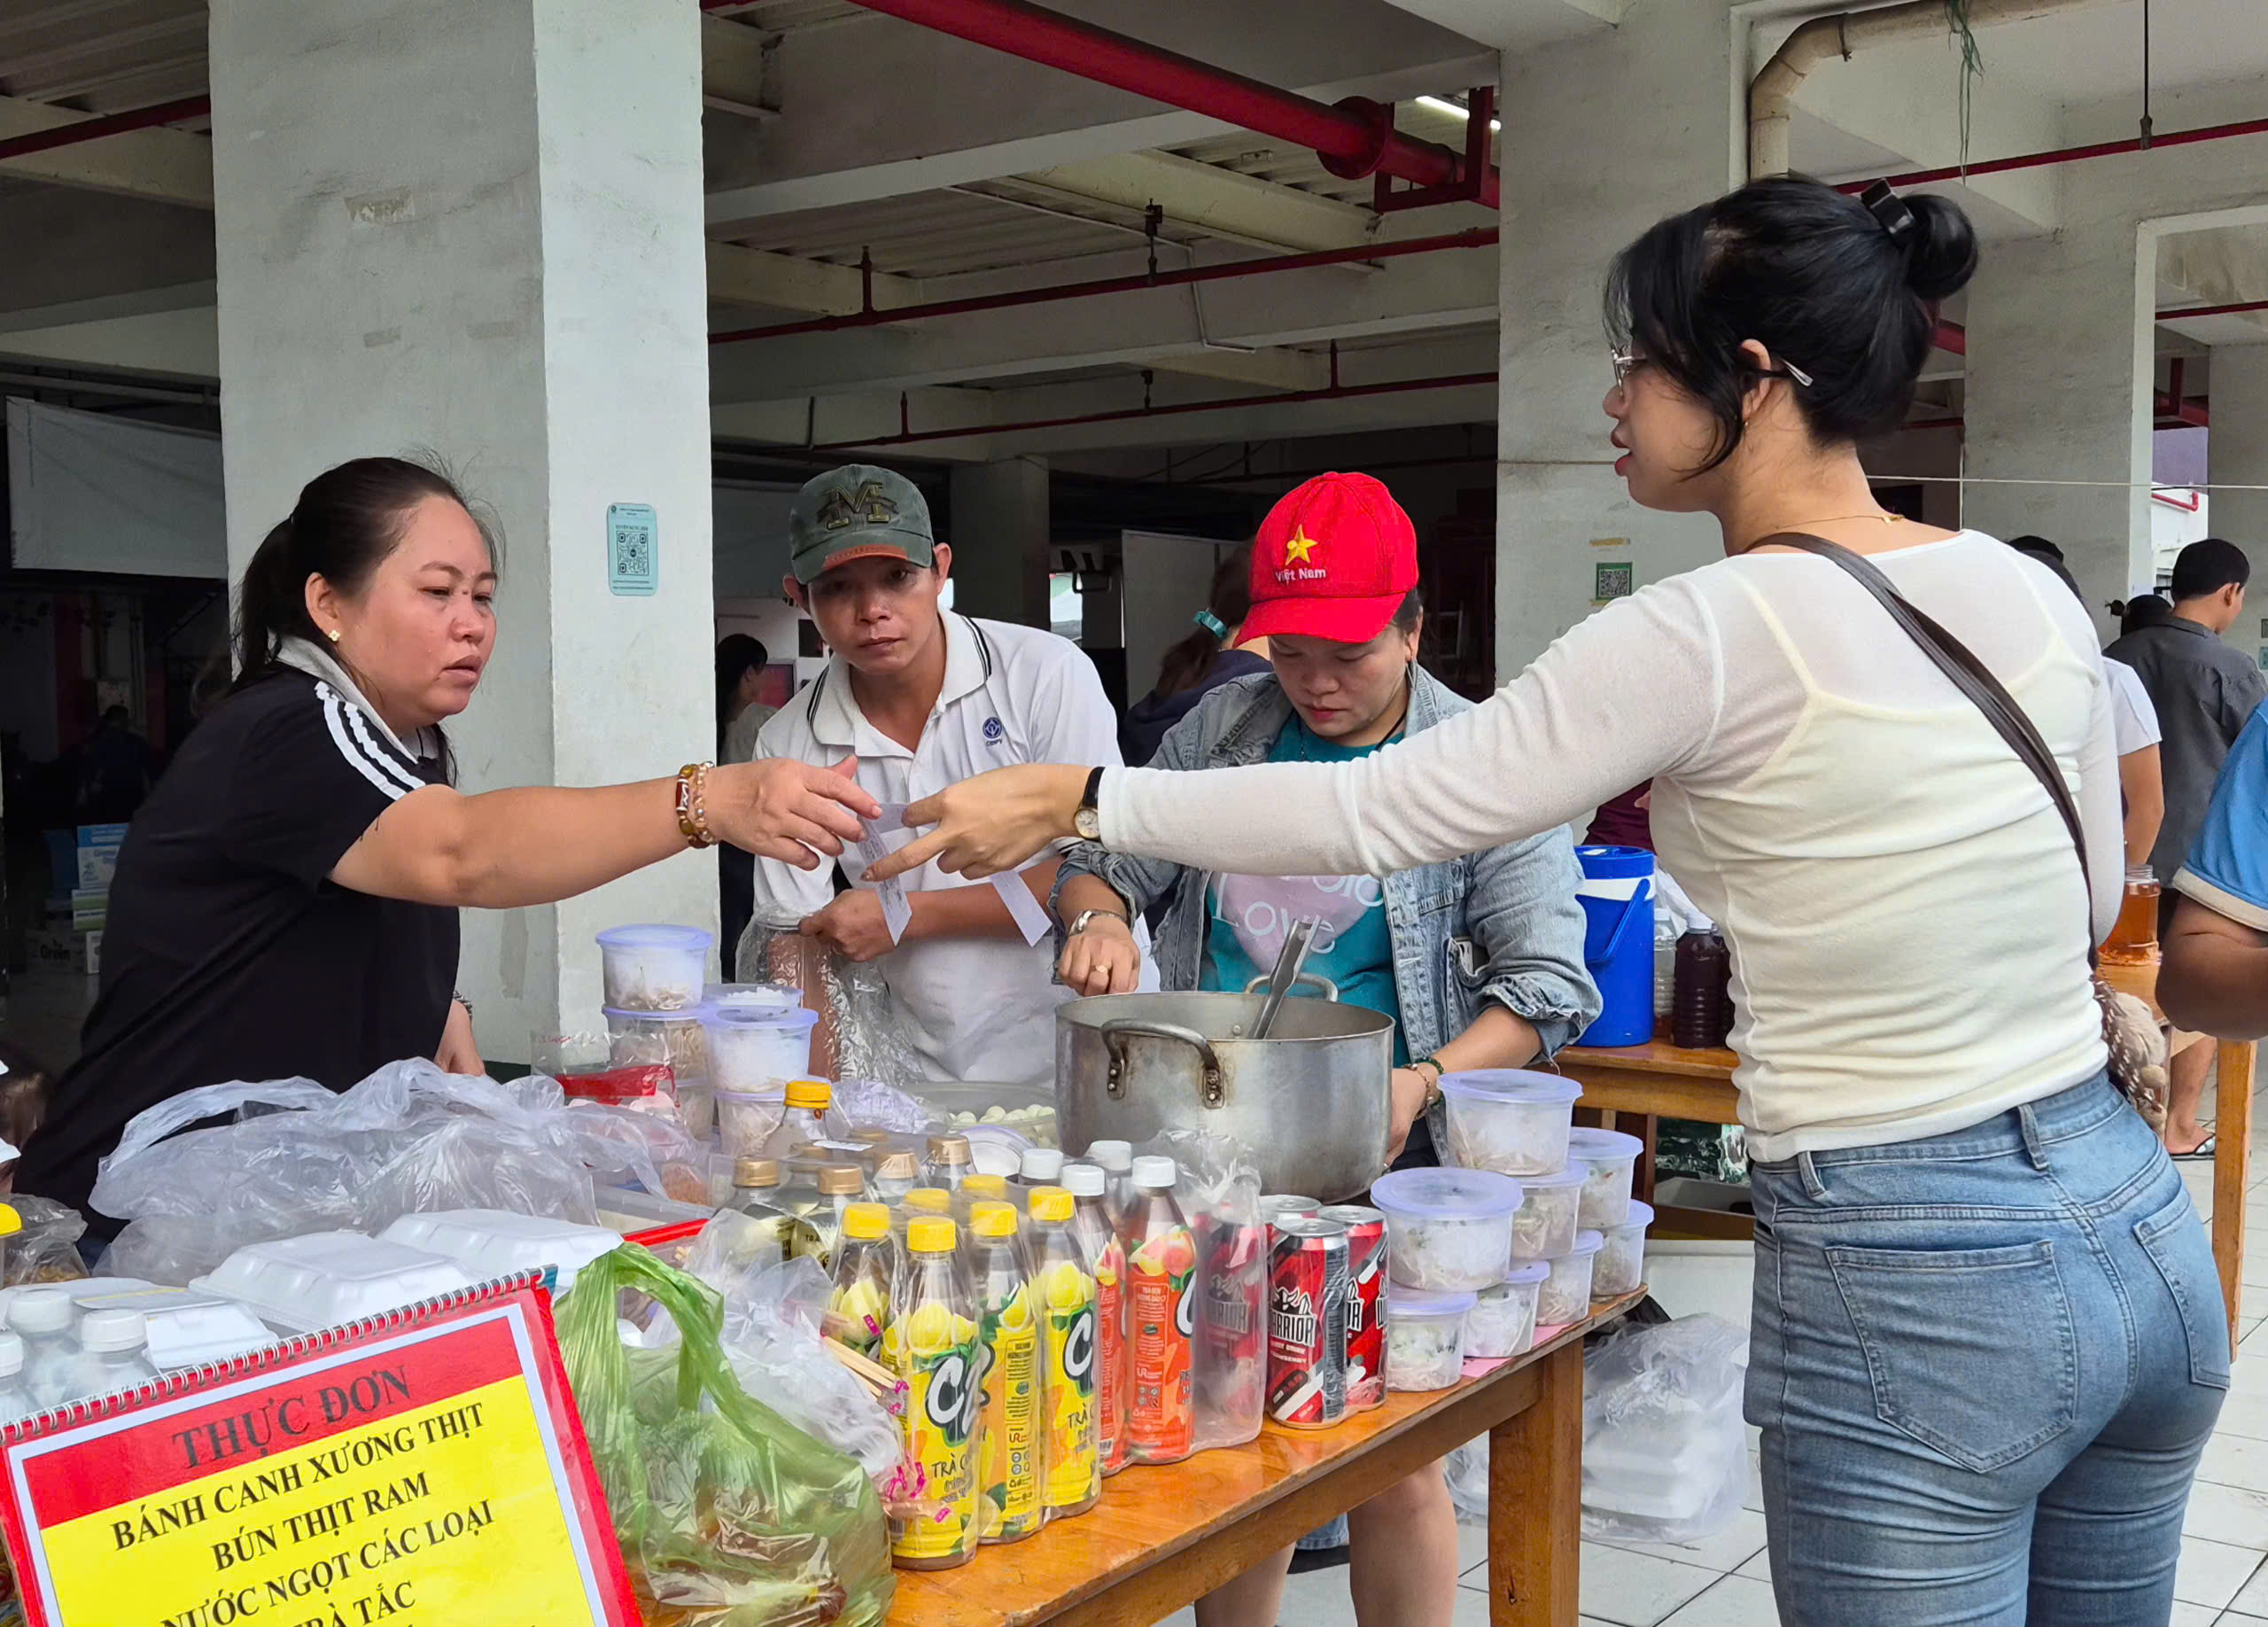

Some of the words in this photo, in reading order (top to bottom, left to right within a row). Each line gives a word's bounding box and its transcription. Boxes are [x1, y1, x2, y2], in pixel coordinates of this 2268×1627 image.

[1276, 568, 1296, 585] Việt
[1299, 567, 1326, 580] Nam
[1270, 1311, 1315, 1345] ARRIOR
[172, 1397, 310, 1468] THỰC
[319, 1366, 411, 1424] ĐƠN
[112, 1495, 206, 1550] BÁNH
[214, 1464, 302, 1514] CANH
[307, 1426, 415, 1483] XƯƠNG
[418, 1403, 483, 1444] THỊT
[931, 1452, 957, 1477] TRÀ
[210, 1525, 278, 1571] BÚN
[283, 1498, 354, 1544] THỊT
[362, 1472, 430, 1516] RAM
[264, 1553, 352, 1607] NGỌT
[360, 1527, 420, 1569] CÁC
[427, 1499, 494, 1545] LOẠI
[353, 1581, 416, 1625] TẮC
